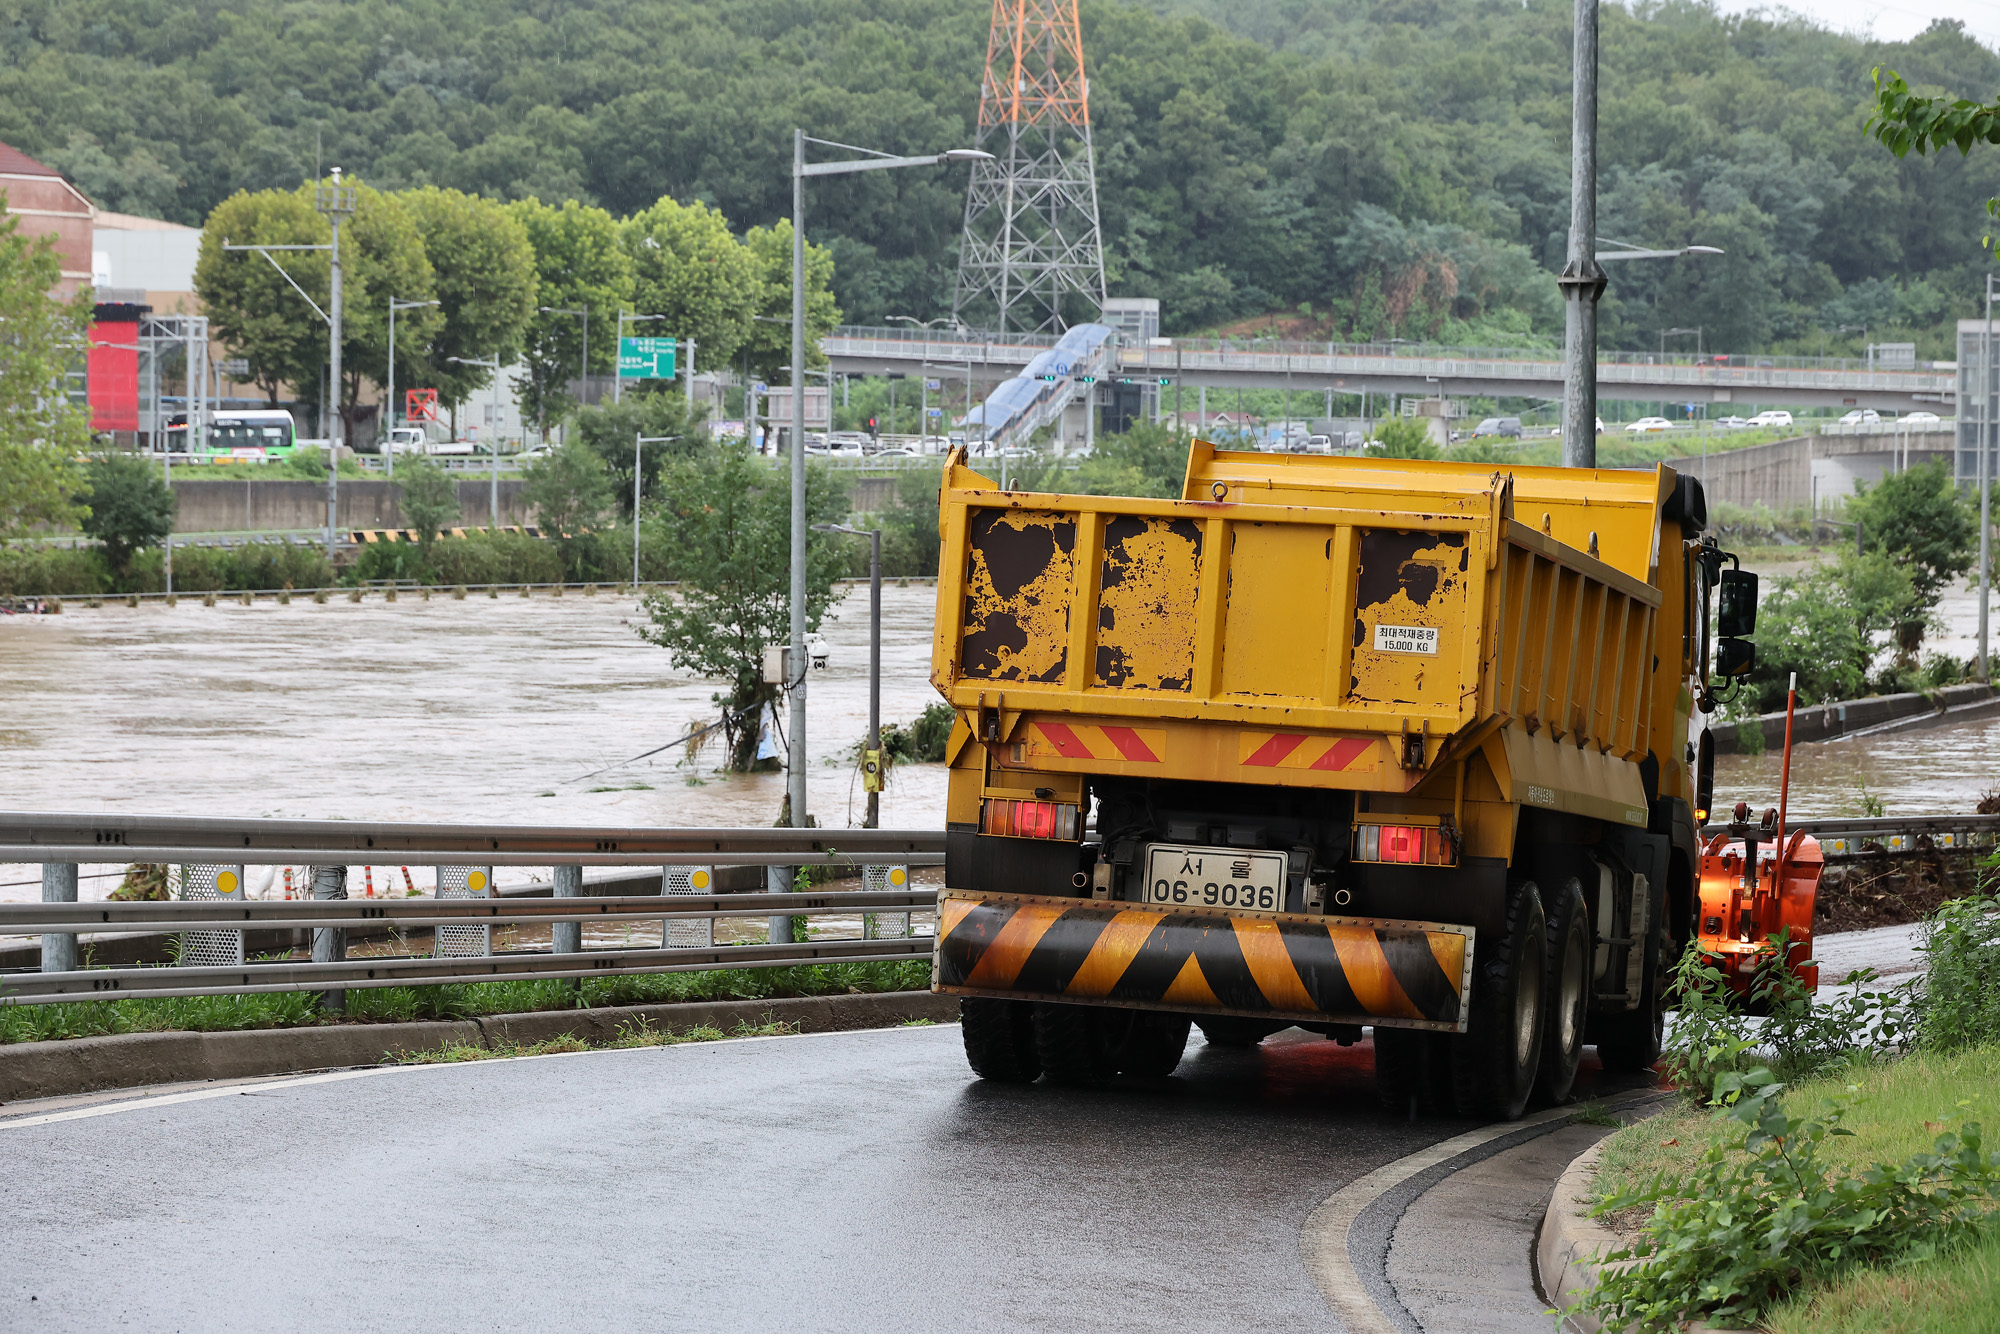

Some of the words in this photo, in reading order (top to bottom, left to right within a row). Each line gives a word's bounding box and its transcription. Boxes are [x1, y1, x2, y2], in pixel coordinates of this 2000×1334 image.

[1379, 627, 1435, 640] 최대적재중량
[1384, 640, 1413, 651] 15,000
[1416, 642, 1429, 652] KG
[1154, 879, 1274, 908] 06-9036
